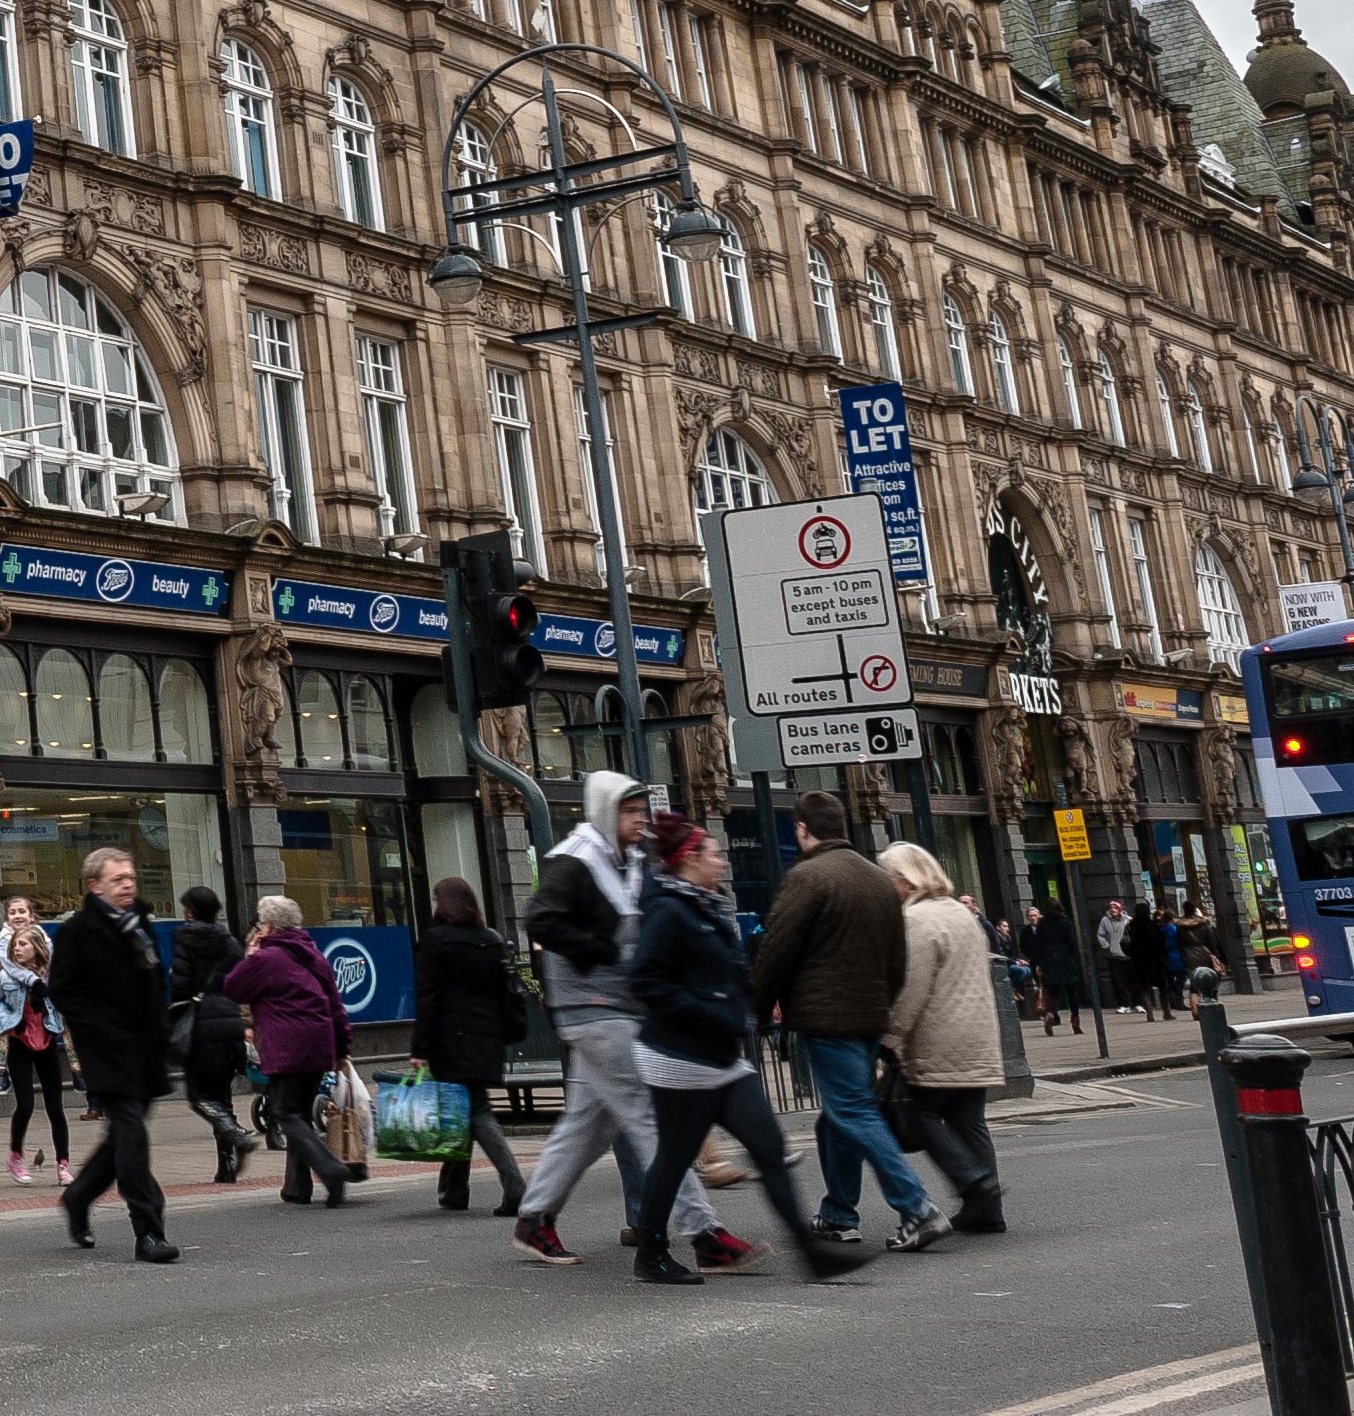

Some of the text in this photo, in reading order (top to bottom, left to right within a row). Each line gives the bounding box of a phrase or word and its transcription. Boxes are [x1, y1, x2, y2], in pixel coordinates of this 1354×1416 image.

[853, 398, 894, 425] TO
[850, 425, 905, 454] LET
[854, 460, 911, 477] Attractive
[1011, 516, 1049, 604] CITY
[27, 560, 87, 586] pharmacy
[152, 575, 190, 598] beauty
[791, 595, 879, 613] except buses
[1285, 591, 1335, 605] NOW WITH
[308, 595, 355, 619] pharmacy
[419, 608, 448, 630] beauty
[806, 609, 868, 626] and taxis
[1288, 606, 1317, 618] 6 NEW
[756, 689, 838, 707] All routes
[1009, 673, 1061, 715] RKETS
[788, 722, 860, 738] Bus lane
[790, 741, 861, 756] cameras
[1, 825, 47, 834] cosmetics
[1314, 886, 1353, 901] 37703
[334, 956, 366, 994] Boots
